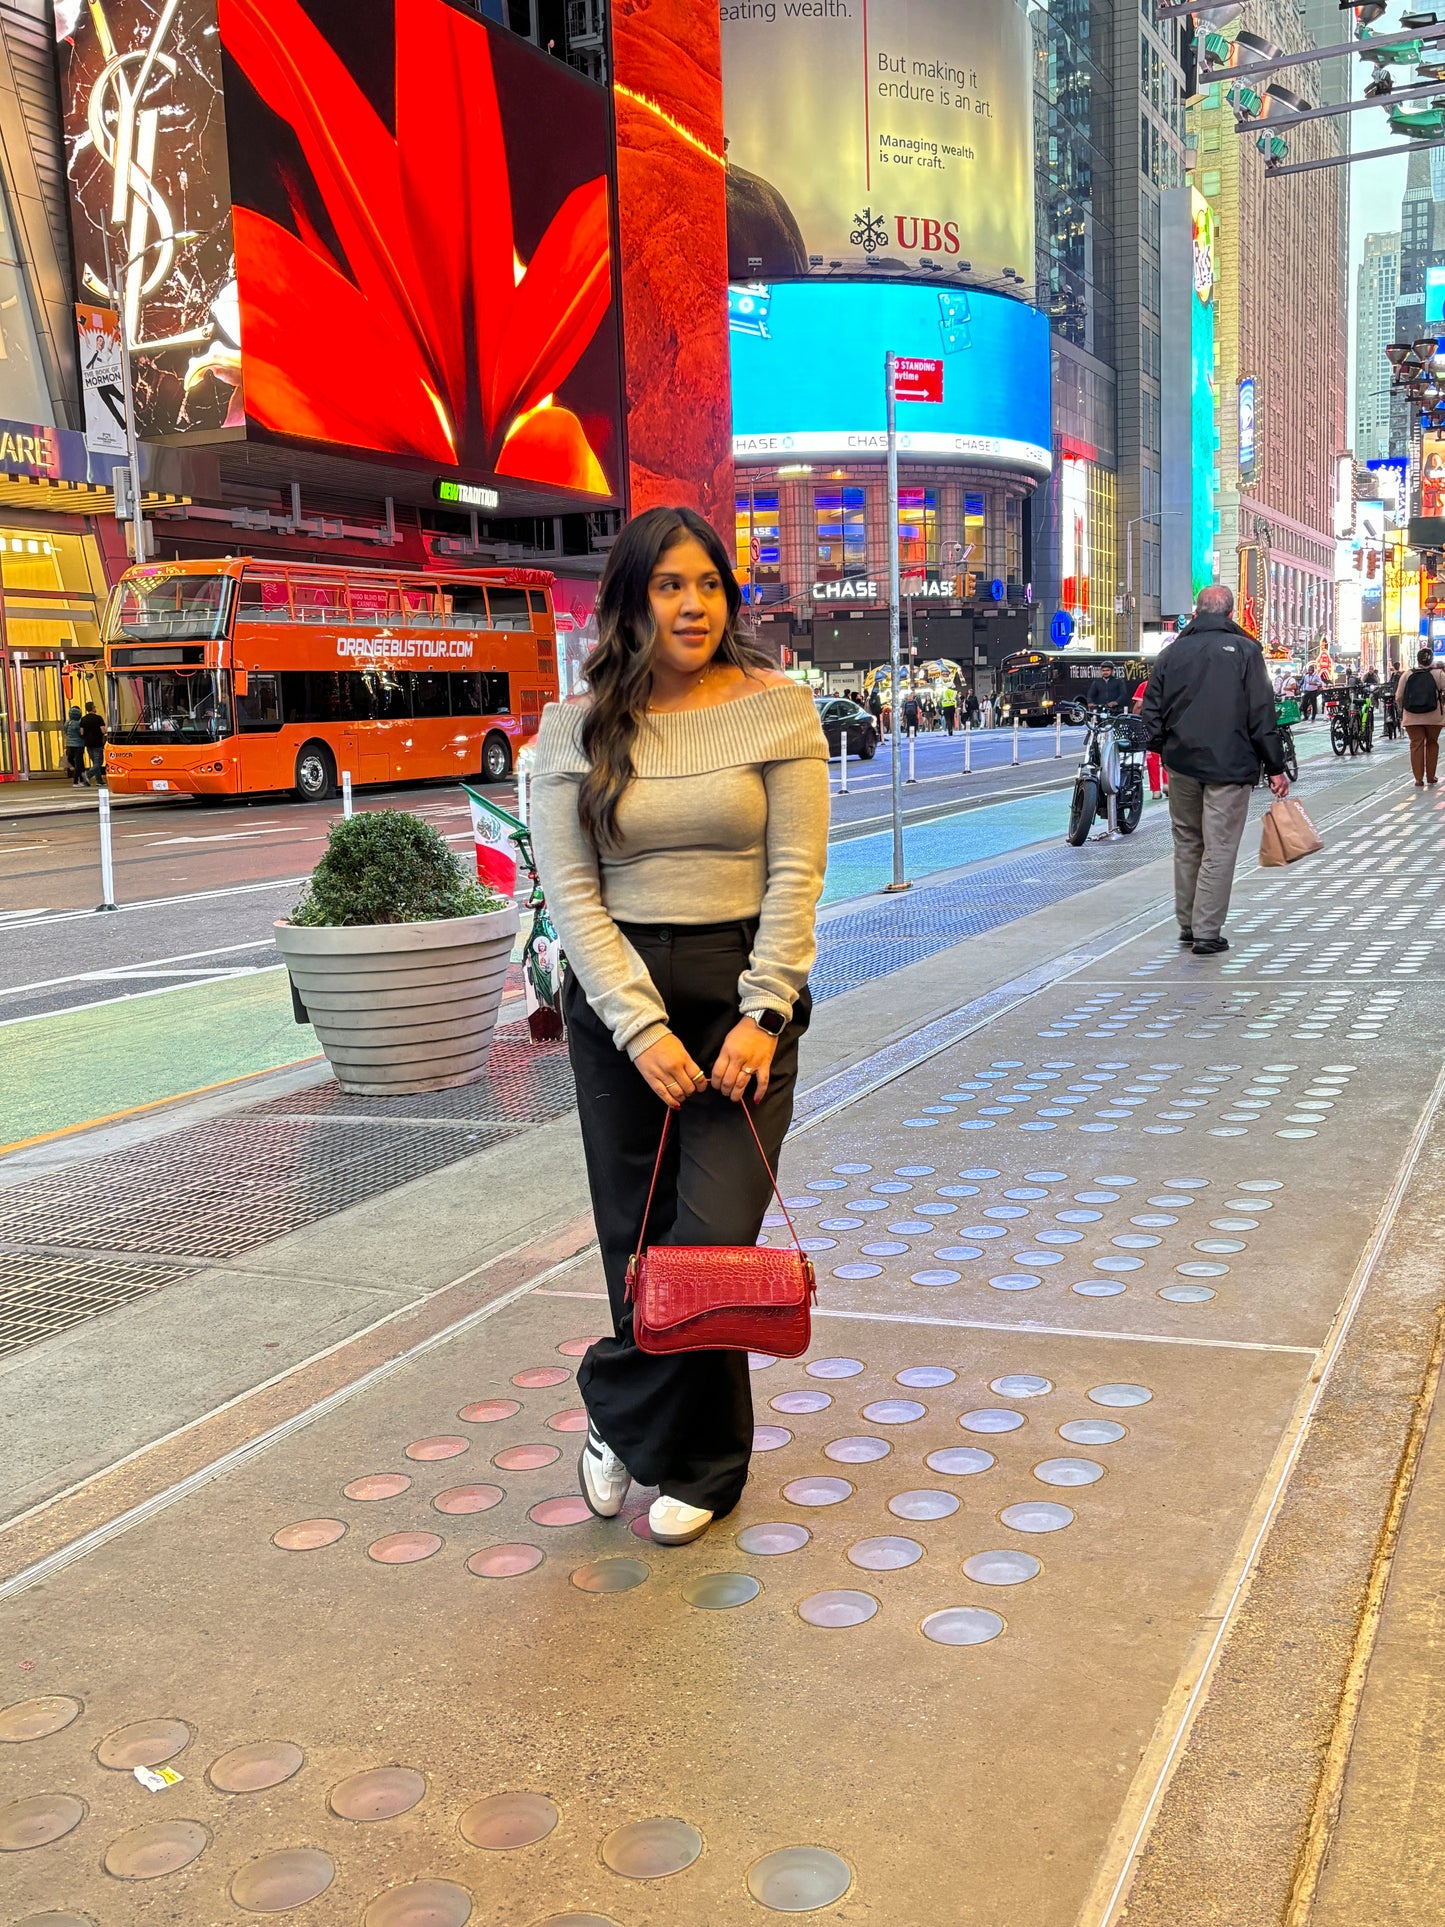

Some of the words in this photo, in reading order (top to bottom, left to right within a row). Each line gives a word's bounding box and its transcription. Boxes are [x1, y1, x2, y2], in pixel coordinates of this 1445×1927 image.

[719, 2, 776, 22] eating
[783, 0, 852, 17] wealth.
[878, 53, 906, 74] But
[913, 60, 965, 89] making
[969, 68, 977, 88] it
[878, 80, 934, 103] endure
[940, 86, 949, 105] is
[955, 94, 970, 111] an
[975, 100, 993, 118] art.
[879, 134, 938, 155] Managing
[941, 144, 975, 160] wealth
[879, 150, 889, 162] is
[893, 154, 913, 165] our
[917, 156, 945, 170] craft.
[894, 215, 961, 255] UBS
[84, 371, 95, 379] THE
[95, 367, 110, 376] BOOK
[901, 361, 936, 372] STANDING
[85, 372, 122, 388] MORMON
[894, 371, 919, 382] nytime
[736, 438, 778, 450] HASE
[848, 435, 888, 447] CHAS
[955, 438, 991, 451] CHASE
[812, 581, 878, 599] CHASE
[902, 581, 954, 598] HASE
[336, 637, 474, 658] ORANGEBUSTOUR.COM
[1069, 665, 1080, 679] THE
